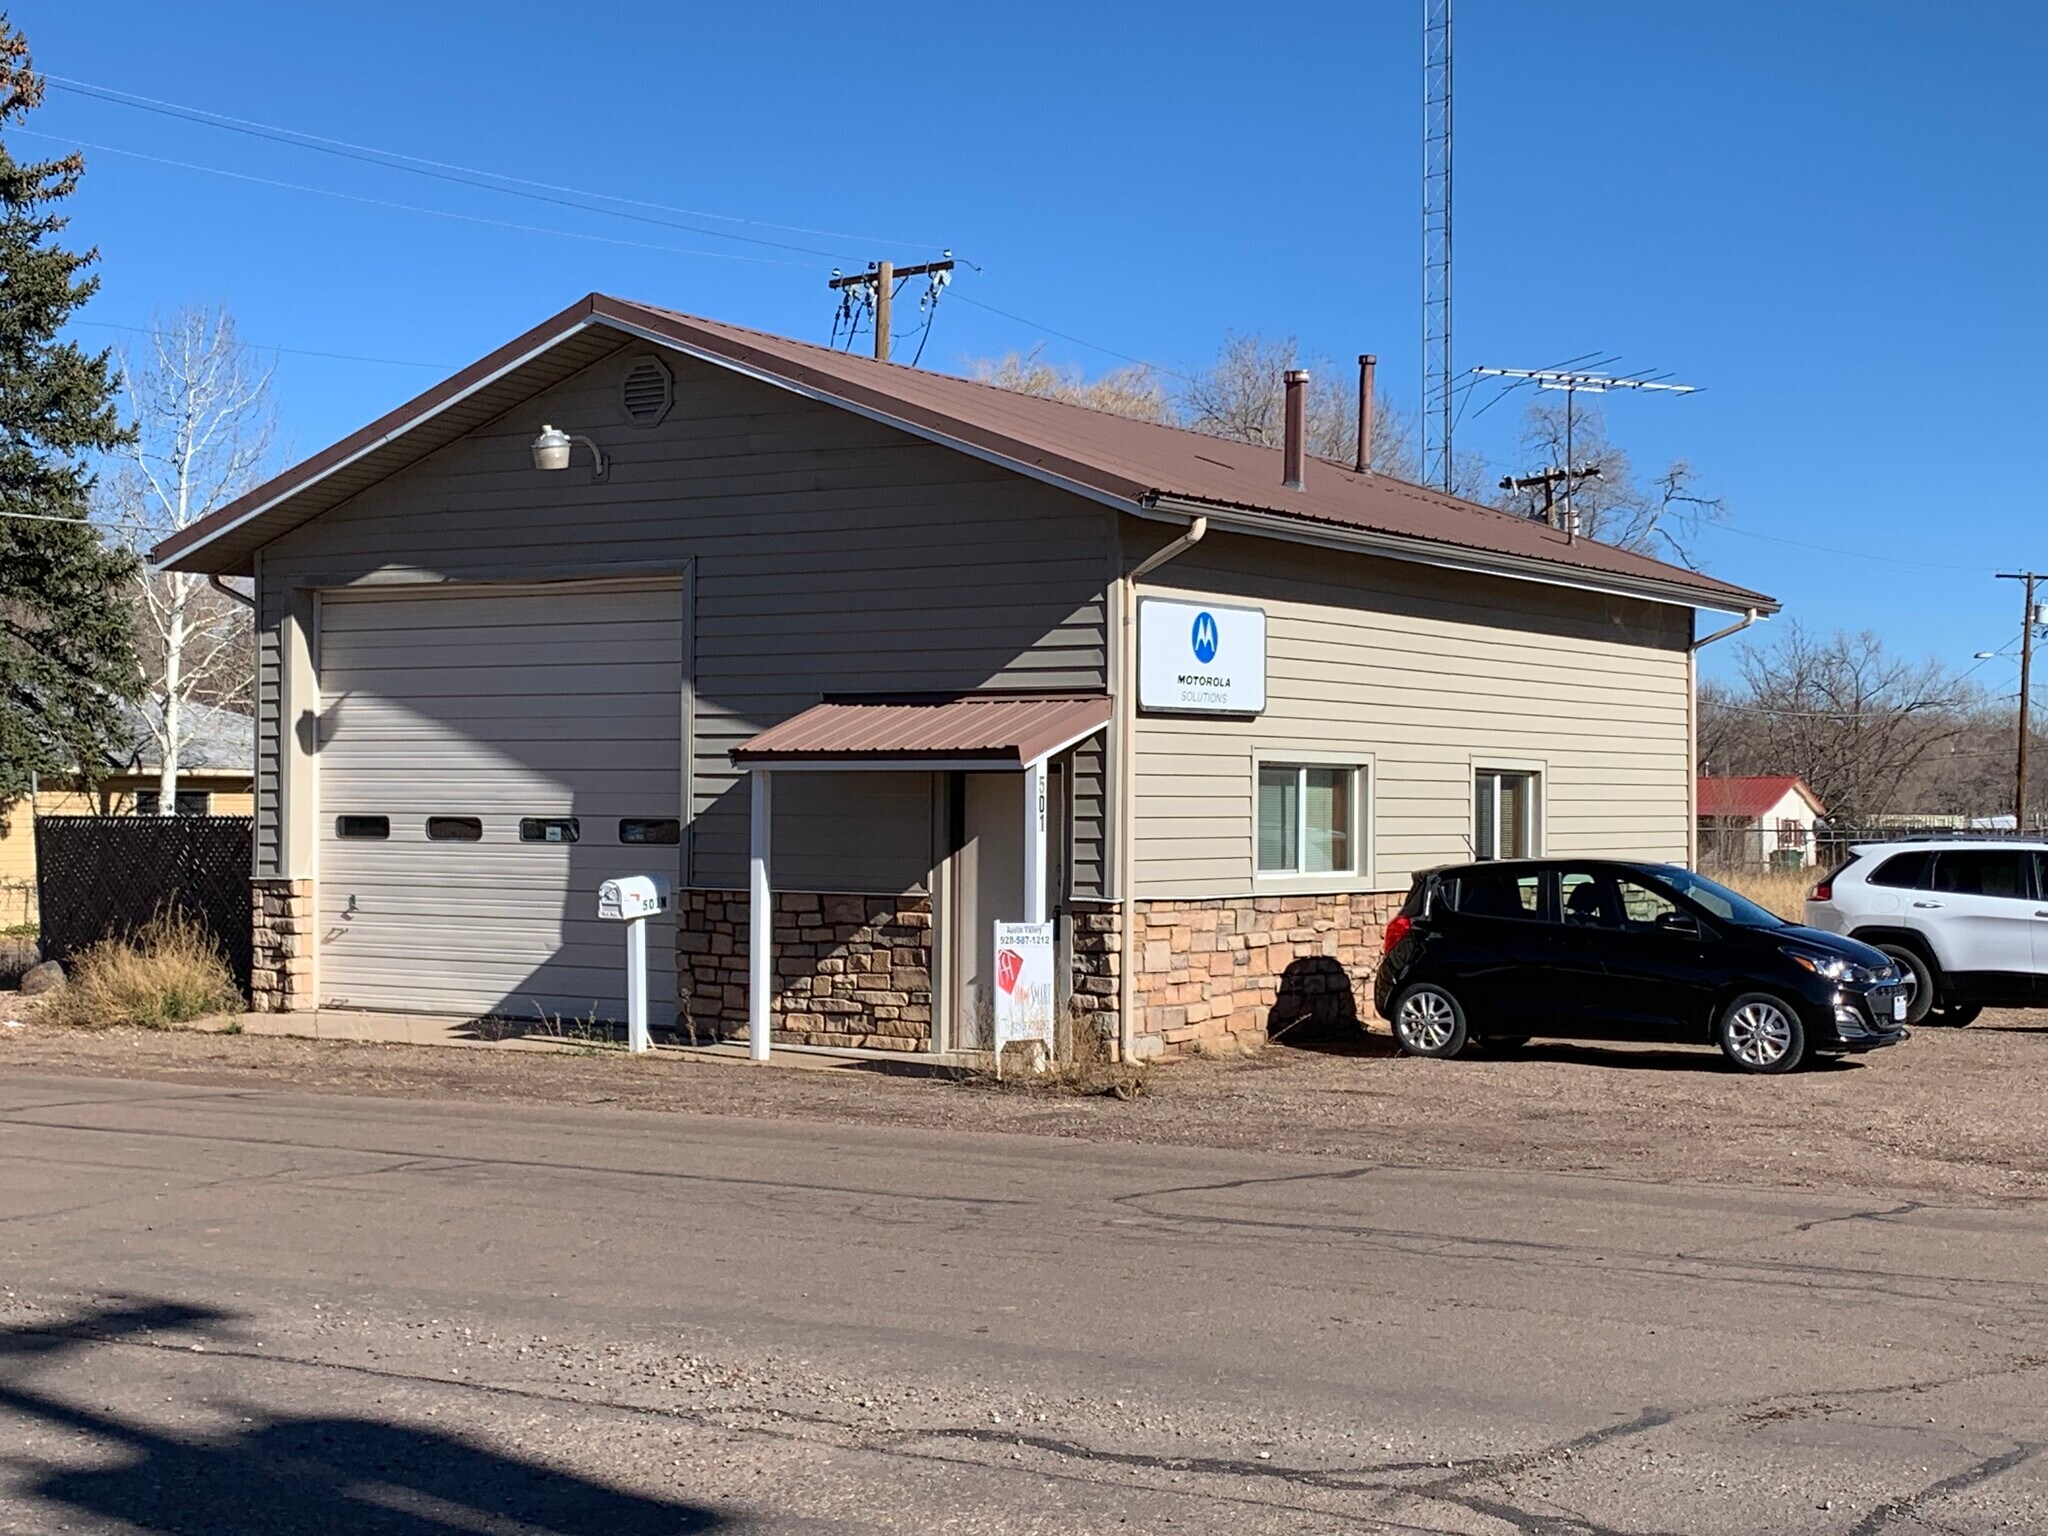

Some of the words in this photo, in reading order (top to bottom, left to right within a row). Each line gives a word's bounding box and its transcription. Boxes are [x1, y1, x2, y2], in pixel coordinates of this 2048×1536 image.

[1177, 674, 1231, 688] MOTOROLA
[1181, 690, 1227, 704] SOLUTIONS
[1000, 936, 1050, 945] 928-587-1212
